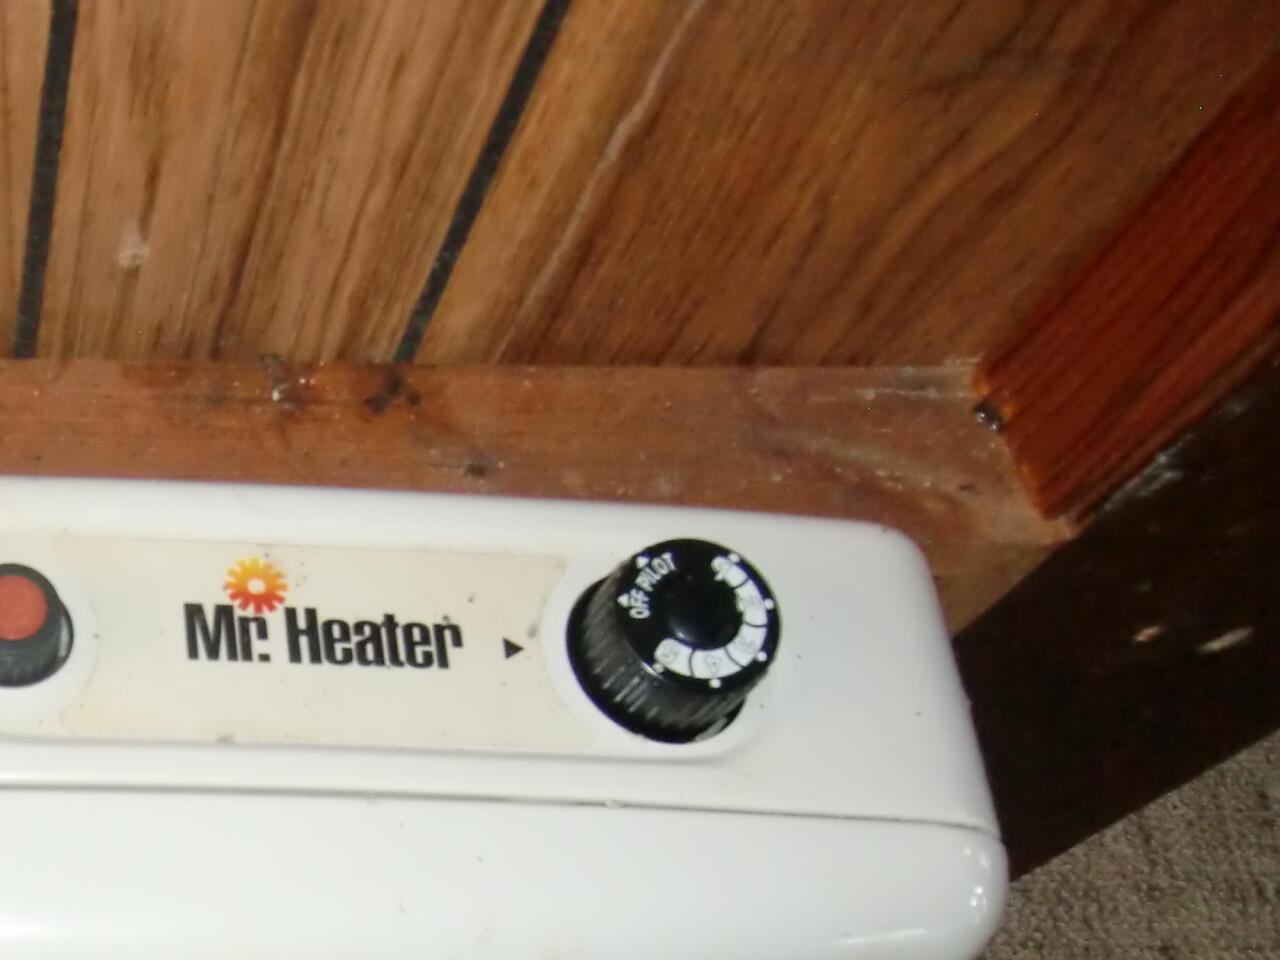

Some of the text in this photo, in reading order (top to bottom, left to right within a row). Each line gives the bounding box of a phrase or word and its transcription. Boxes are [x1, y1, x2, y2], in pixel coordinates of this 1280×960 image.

[635, 552, 677, 591] PILOT
[628, 589, 650, 619] OFF
[183, 602, 464, 669] Mr. Heater
